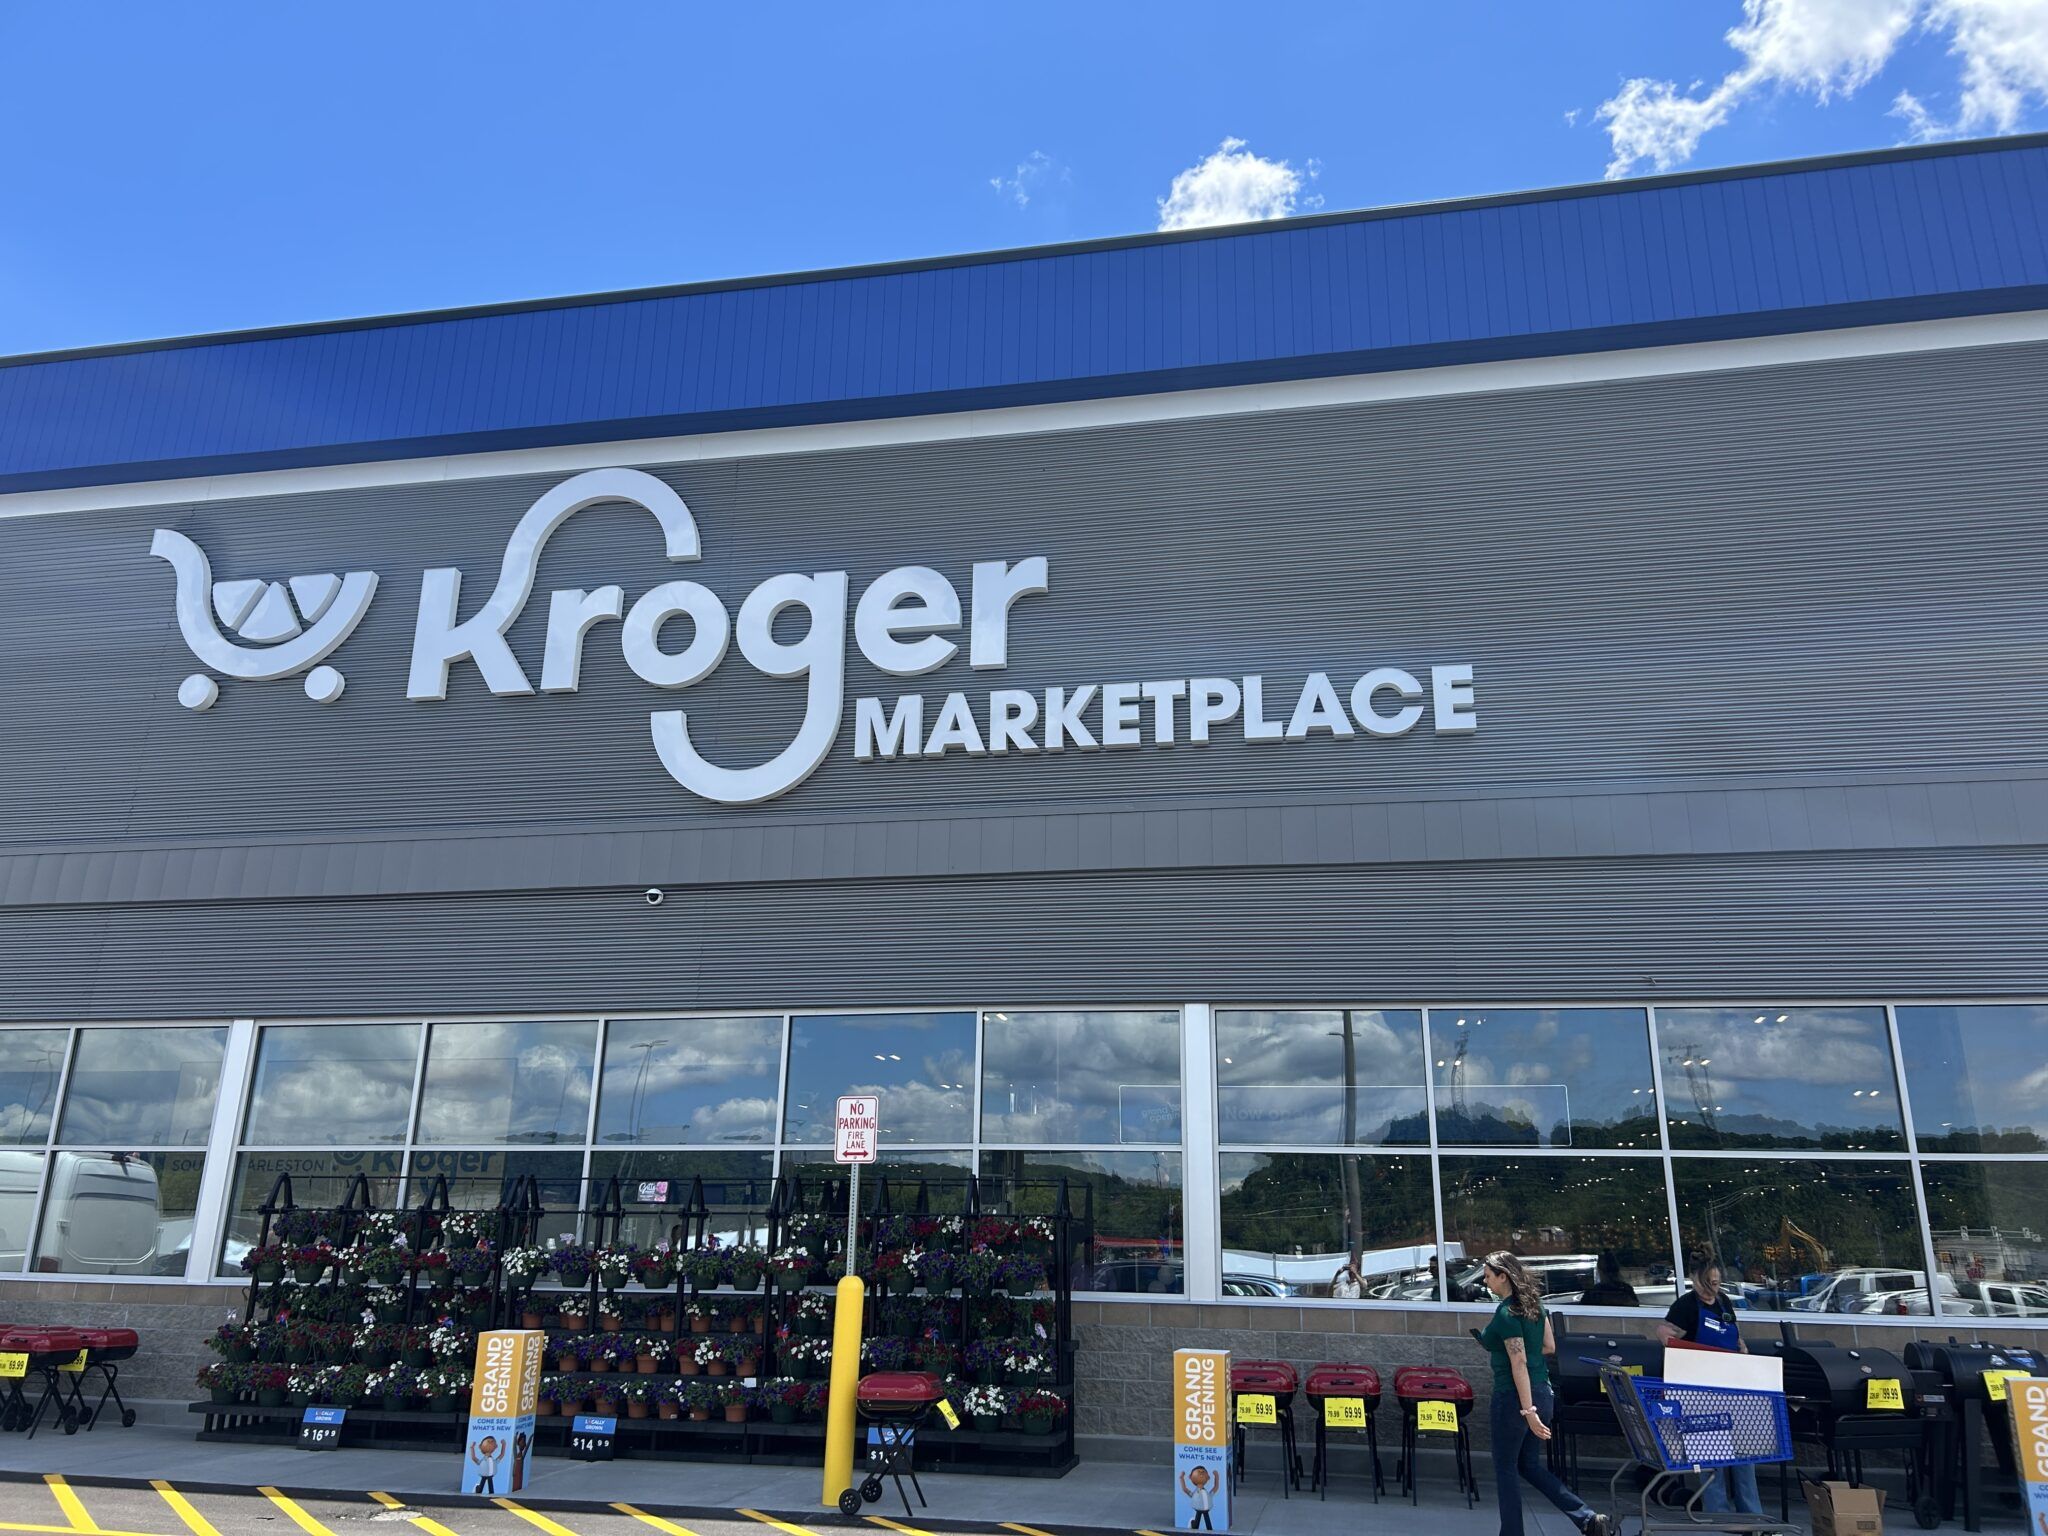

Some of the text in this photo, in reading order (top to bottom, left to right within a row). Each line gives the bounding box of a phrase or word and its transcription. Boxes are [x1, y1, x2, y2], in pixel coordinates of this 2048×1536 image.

[407, 467, 1048, 805] Kroger
[854, 663, 1478, 763] MARKETPLACE
[850, 1103, 864, 1115] NO
[838, 1117, 875, 1129] PARKING
[848, 1131, 864, 1139] FIRE
[846, 1140, 866, 1148] LANE
[248, 1158, 325, 1172] ARLESTON
[481, 1337, 502, 1412] GRAND
[496, 1337, 515, 1413] OPENING
[1185, 1357, 1202, 1440] GRAND
[1202, 1358, 1216, 1441] OPENING
[1256, 1402, 1273, 1415] 69.99
[1344, 1406, 1362, 1419] 69.99
[1437, 1409, 1455, 1423] 69.99
[2026, 1385, 2048, 1477] GRAND
